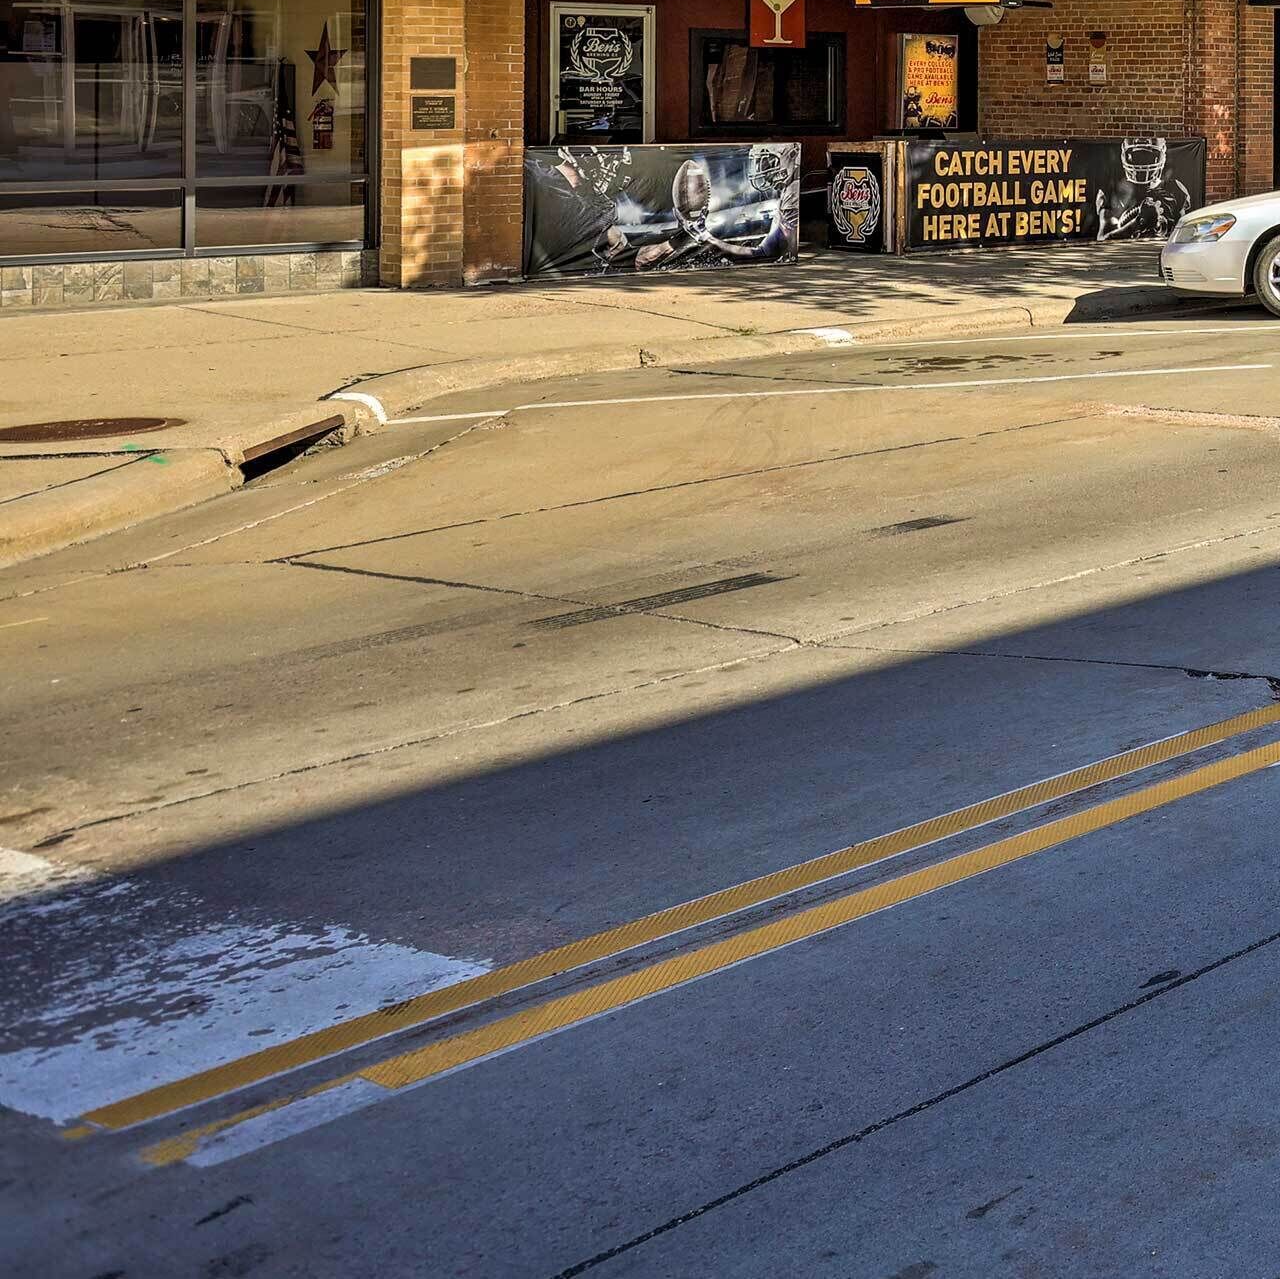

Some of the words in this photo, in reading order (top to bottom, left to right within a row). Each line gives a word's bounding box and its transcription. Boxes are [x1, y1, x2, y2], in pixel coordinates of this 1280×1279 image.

[583, 38, 621, 53] Ben's
[935, 150, 1003, 177] CATCH
[1008, 150, 1073, 174] EVERY
[917, 181, 1026, 209] FOOTBALL
[1030, 179, 1087, 205] GAME
[923, 213, 981, 241] HERE
[985, 212, 1011, 237] AT
[1015, 209, 1082, 236] BEN'S!
